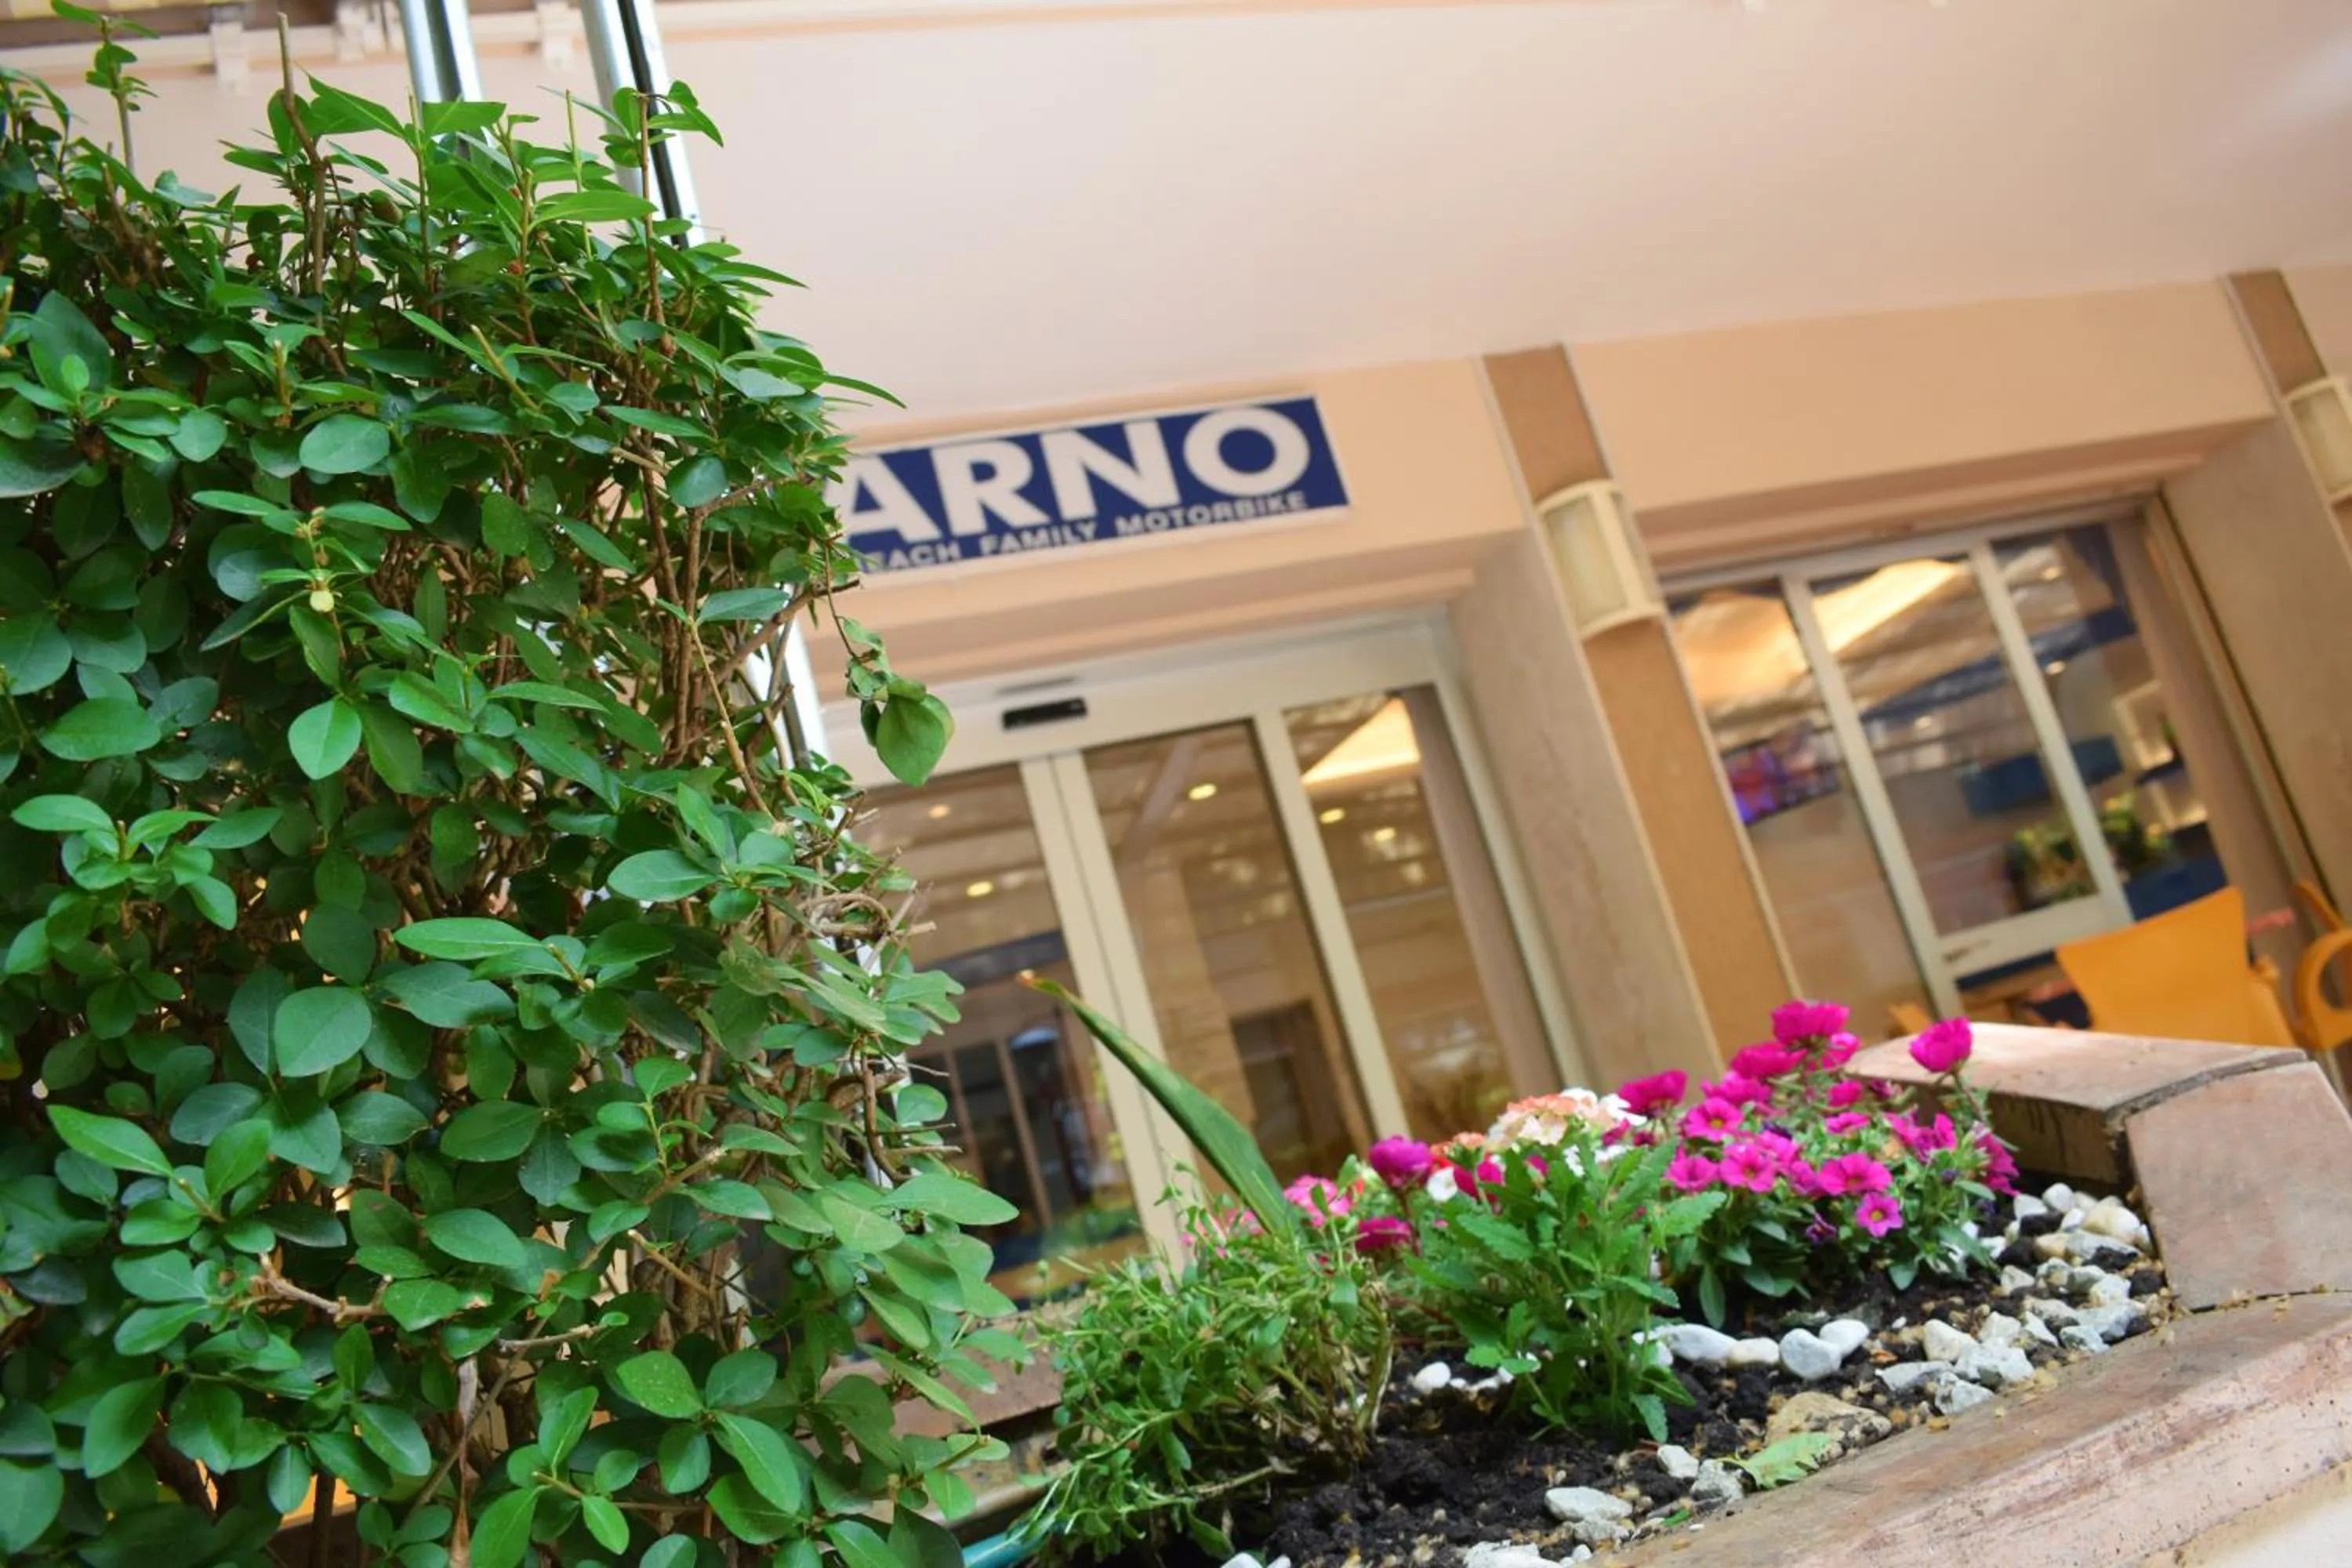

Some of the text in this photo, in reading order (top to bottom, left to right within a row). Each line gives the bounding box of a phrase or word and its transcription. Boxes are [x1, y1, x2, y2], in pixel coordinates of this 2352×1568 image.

[823, 406, 1311, 546] ARNO
[858, 491, 1308, 572] EACH FAMILY MOTORBIKE
